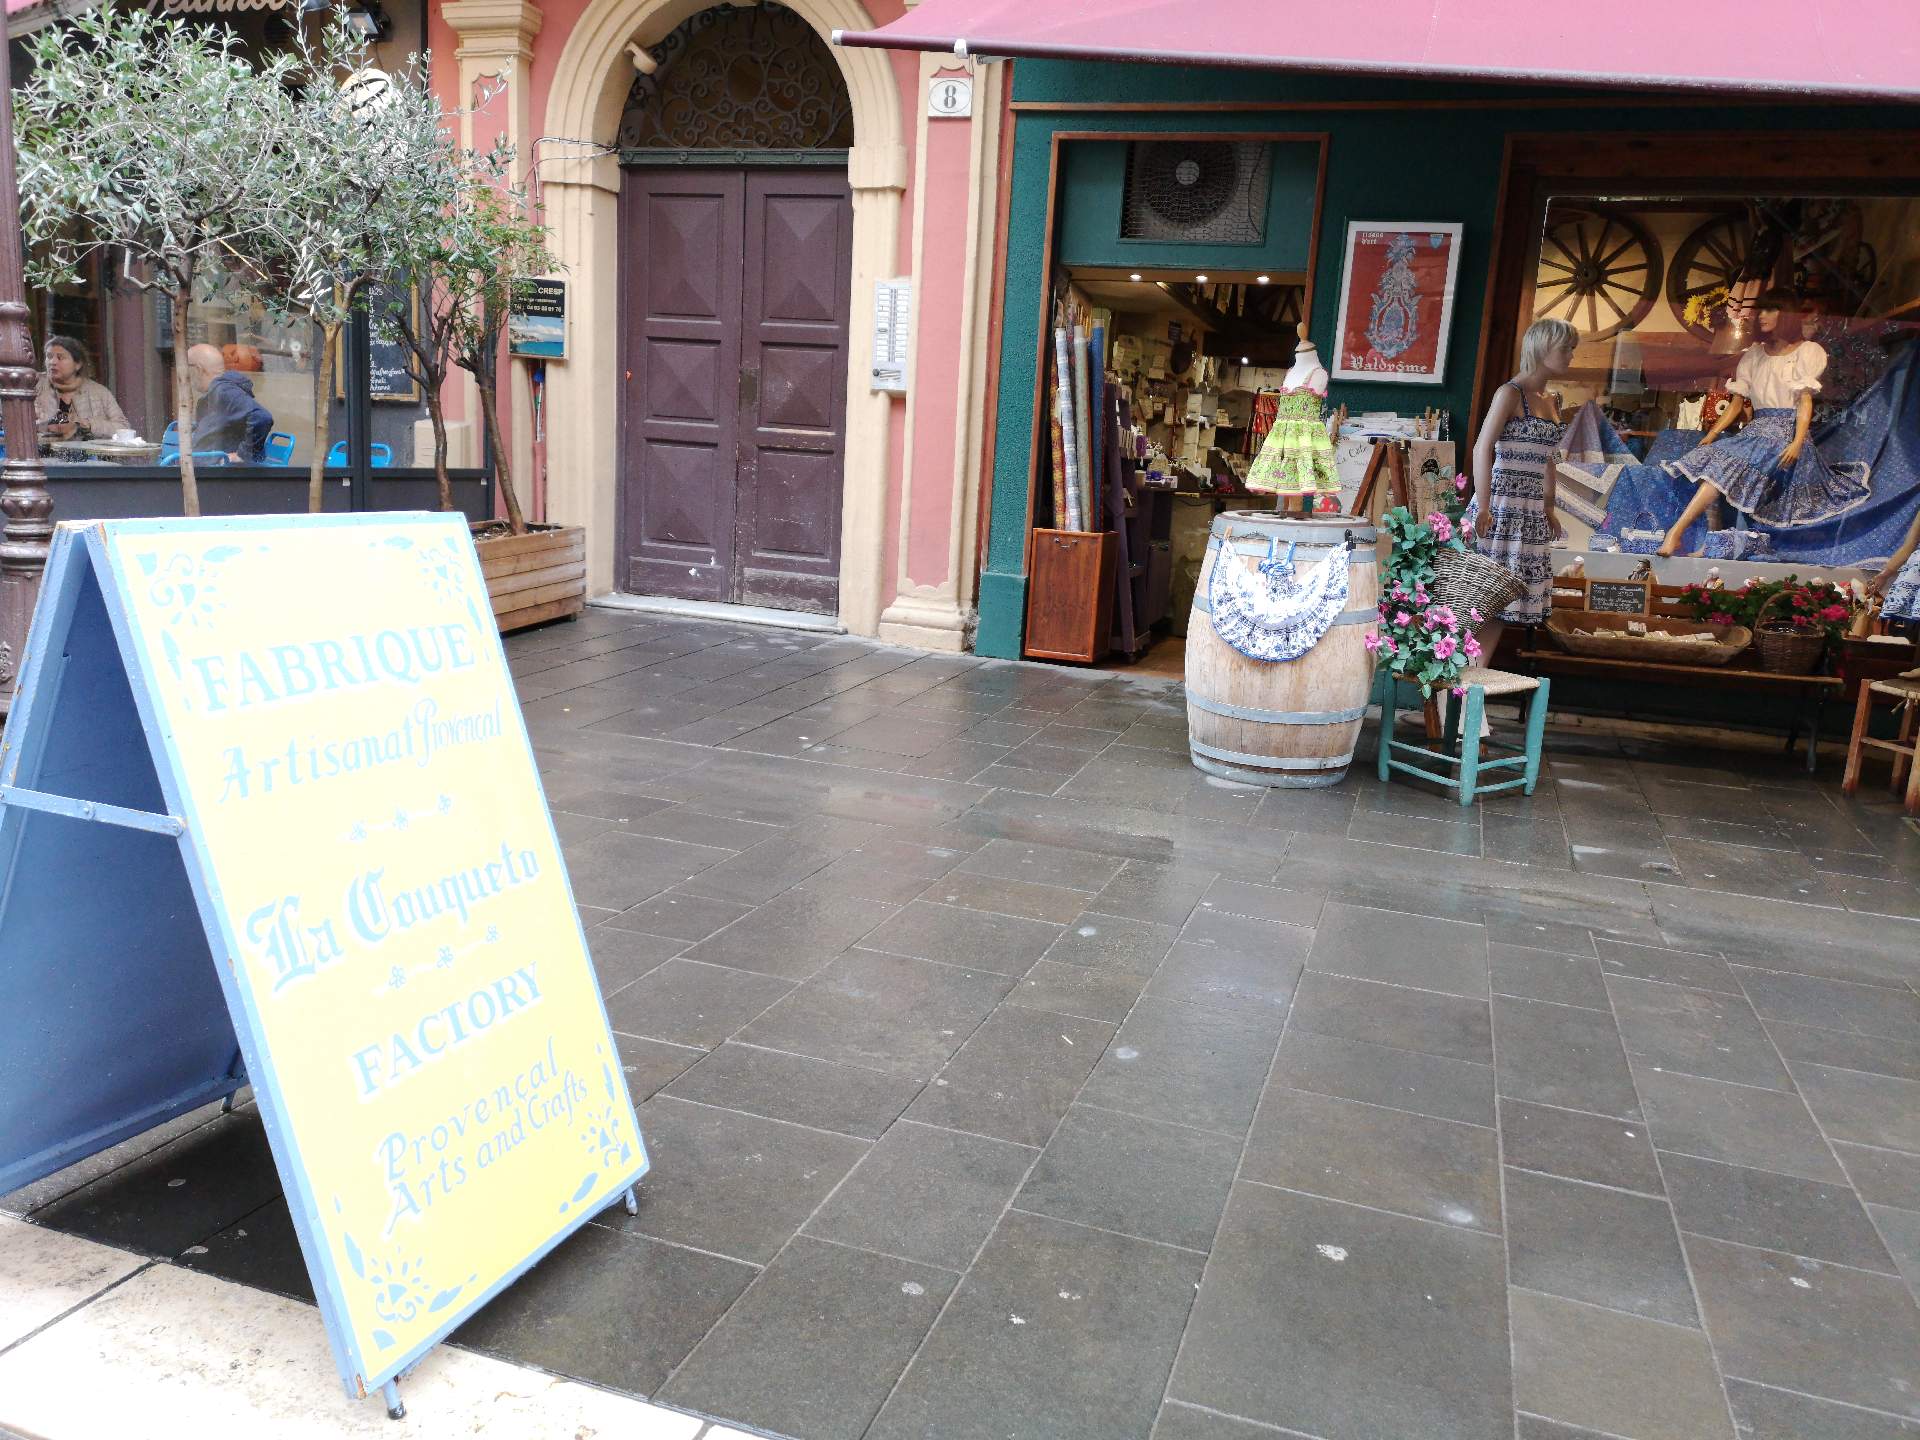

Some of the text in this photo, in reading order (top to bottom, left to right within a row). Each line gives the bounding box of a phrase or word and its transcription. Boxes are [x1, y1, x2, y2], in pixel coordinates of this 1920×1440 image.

[944, 85, 957, 108] 8
[537, 287, 563, 295] CRESP
[192, 623, 475, 712] FABRIQUE
[220, 714, 416, 802] Artisanat
[246, 840, 540, 992] La Couqueto
[352, 961, 543, 1095] FACTORY
[379, 1035, 559, 1181] Provençal
[387, 1070, 588, 1235] Arts and Crafts
